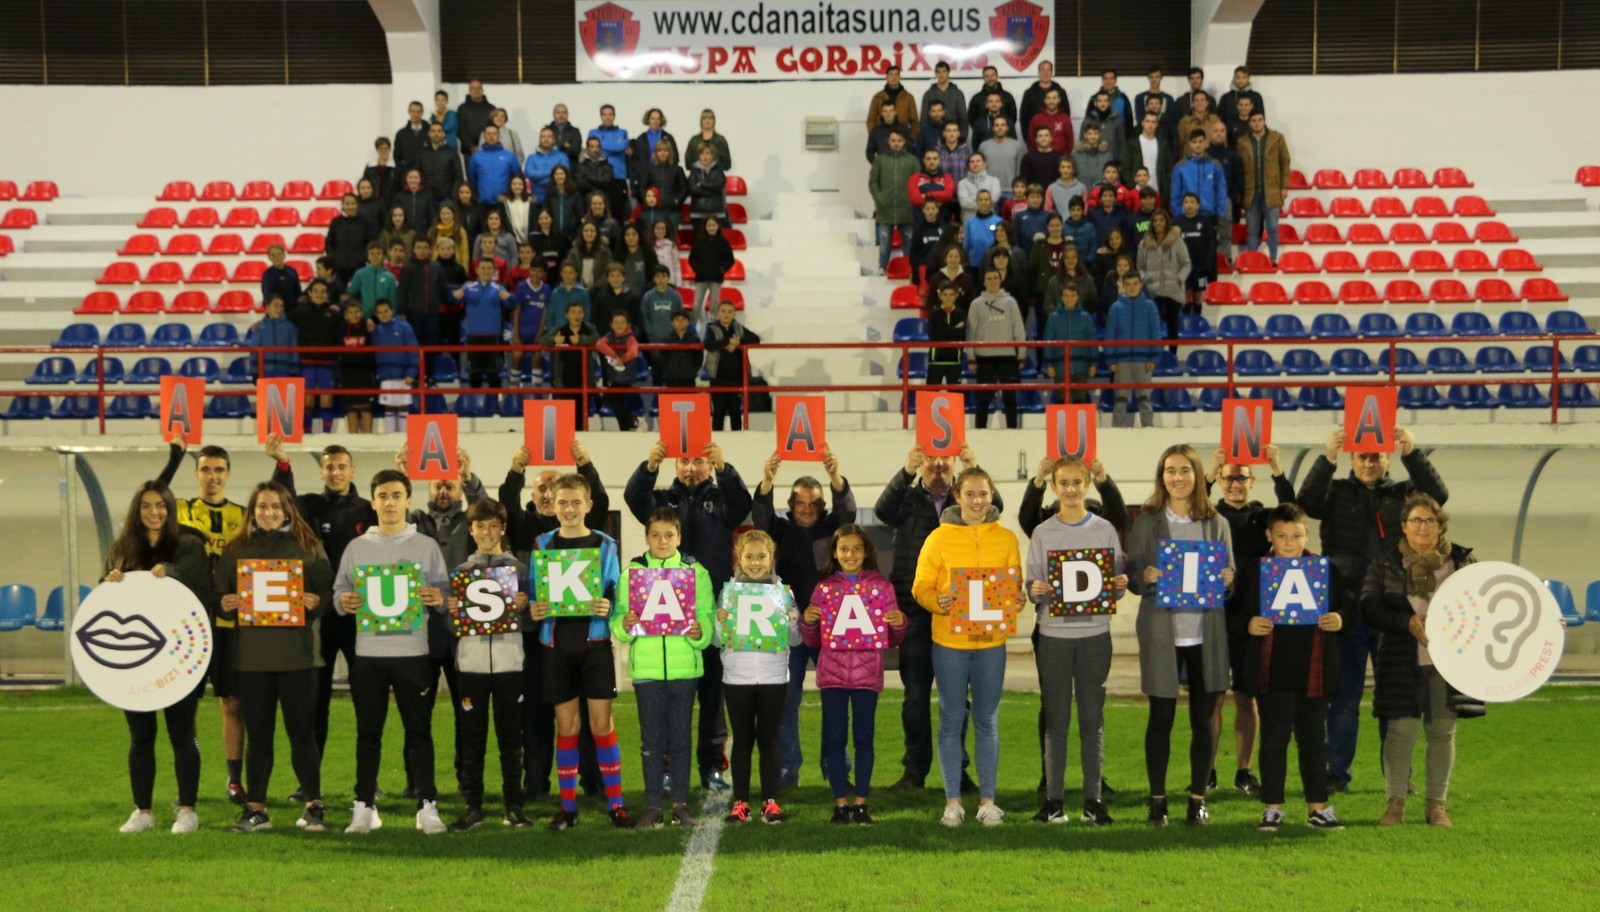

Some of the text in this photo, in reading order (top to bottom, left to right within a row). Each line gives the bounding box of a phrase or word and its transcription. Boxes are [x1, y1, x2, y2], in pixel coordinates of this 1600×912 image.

[653, 3, 980, 34] www.cdanaitasuna.eus
[167, 383, 1385, 471] A N A I T A S U N A
[253, 551, 1318, 637] E U S K A R A L D I A
[127, 667, 181, 696] AHOBIZI
